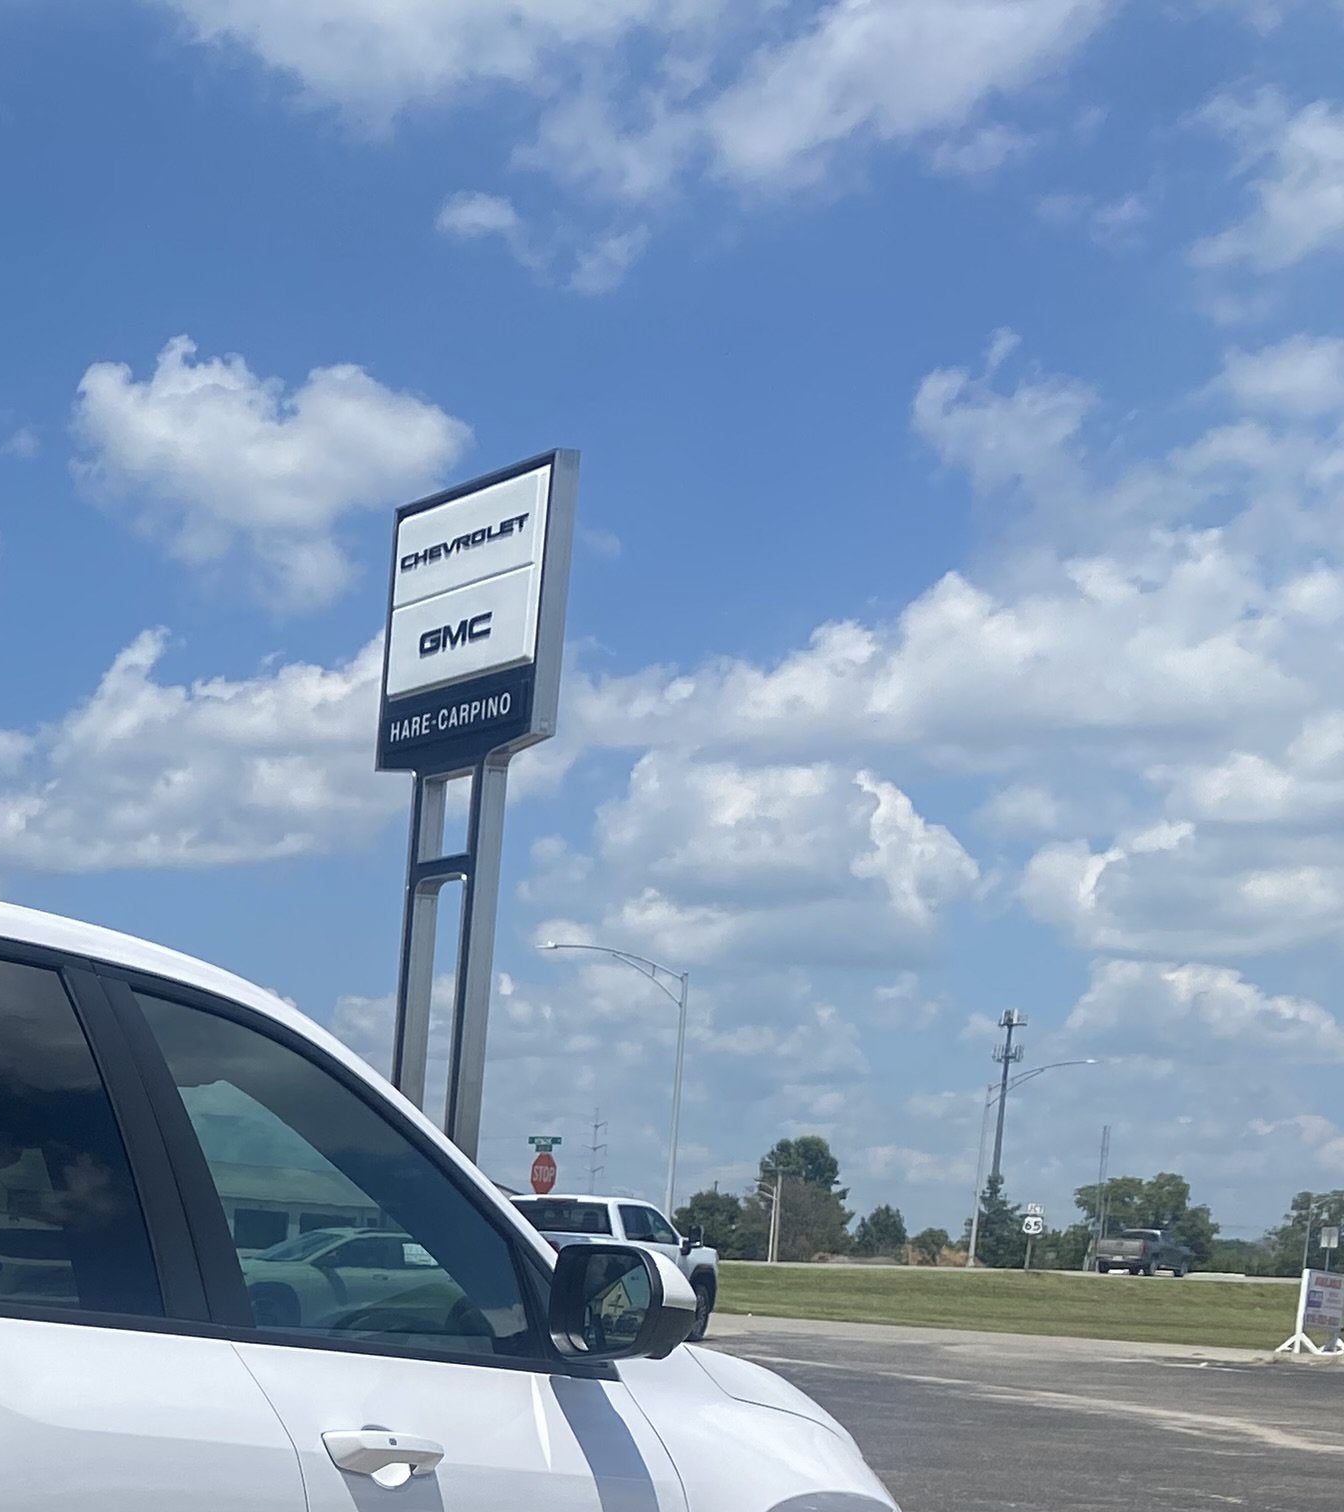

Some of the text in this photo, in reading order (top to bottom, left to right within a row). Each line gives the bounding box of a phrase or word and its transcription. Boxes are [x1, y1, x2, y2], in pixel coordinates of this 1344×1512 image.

[400, 513, 530, 568] CHEVROLET
[419, 612, 492, 655] GMC
[390, 692, 511, 742] HARE-CARPINO
[533, 1165, 555, 1182] STOP
[1025, 1220, 1041, 1231] 65
